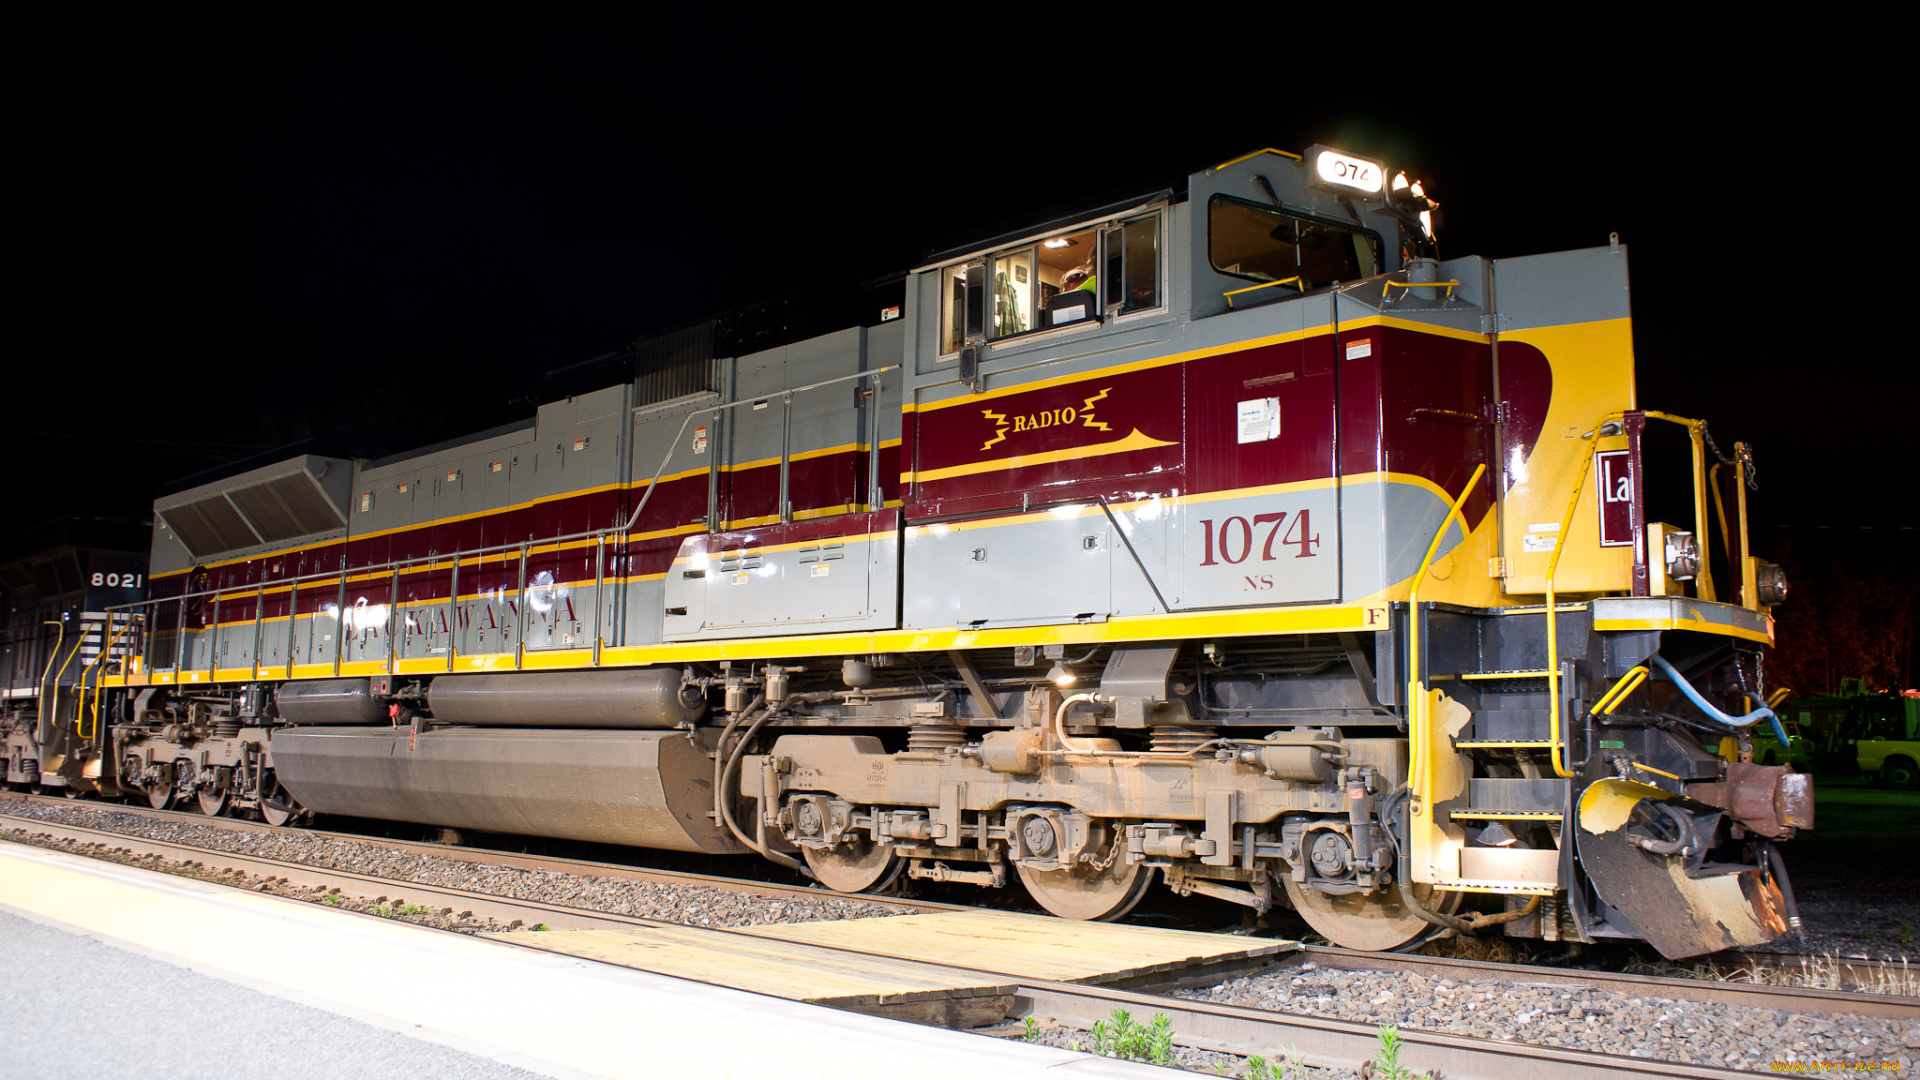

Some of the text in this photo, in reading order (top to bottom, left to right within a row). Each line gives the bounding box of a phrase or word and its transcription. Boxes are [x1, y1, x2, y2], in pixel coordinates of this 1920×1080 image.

[1329, 159, 1369, 182] 074
[1012, 406, 1077, 433] RADIO
[1199, 508, 1320, 567] 1074
[91, 572, 142, 588] 8021
[1242, 574, 1274, 591] NS
[1367, 607, 1386, 625] F
